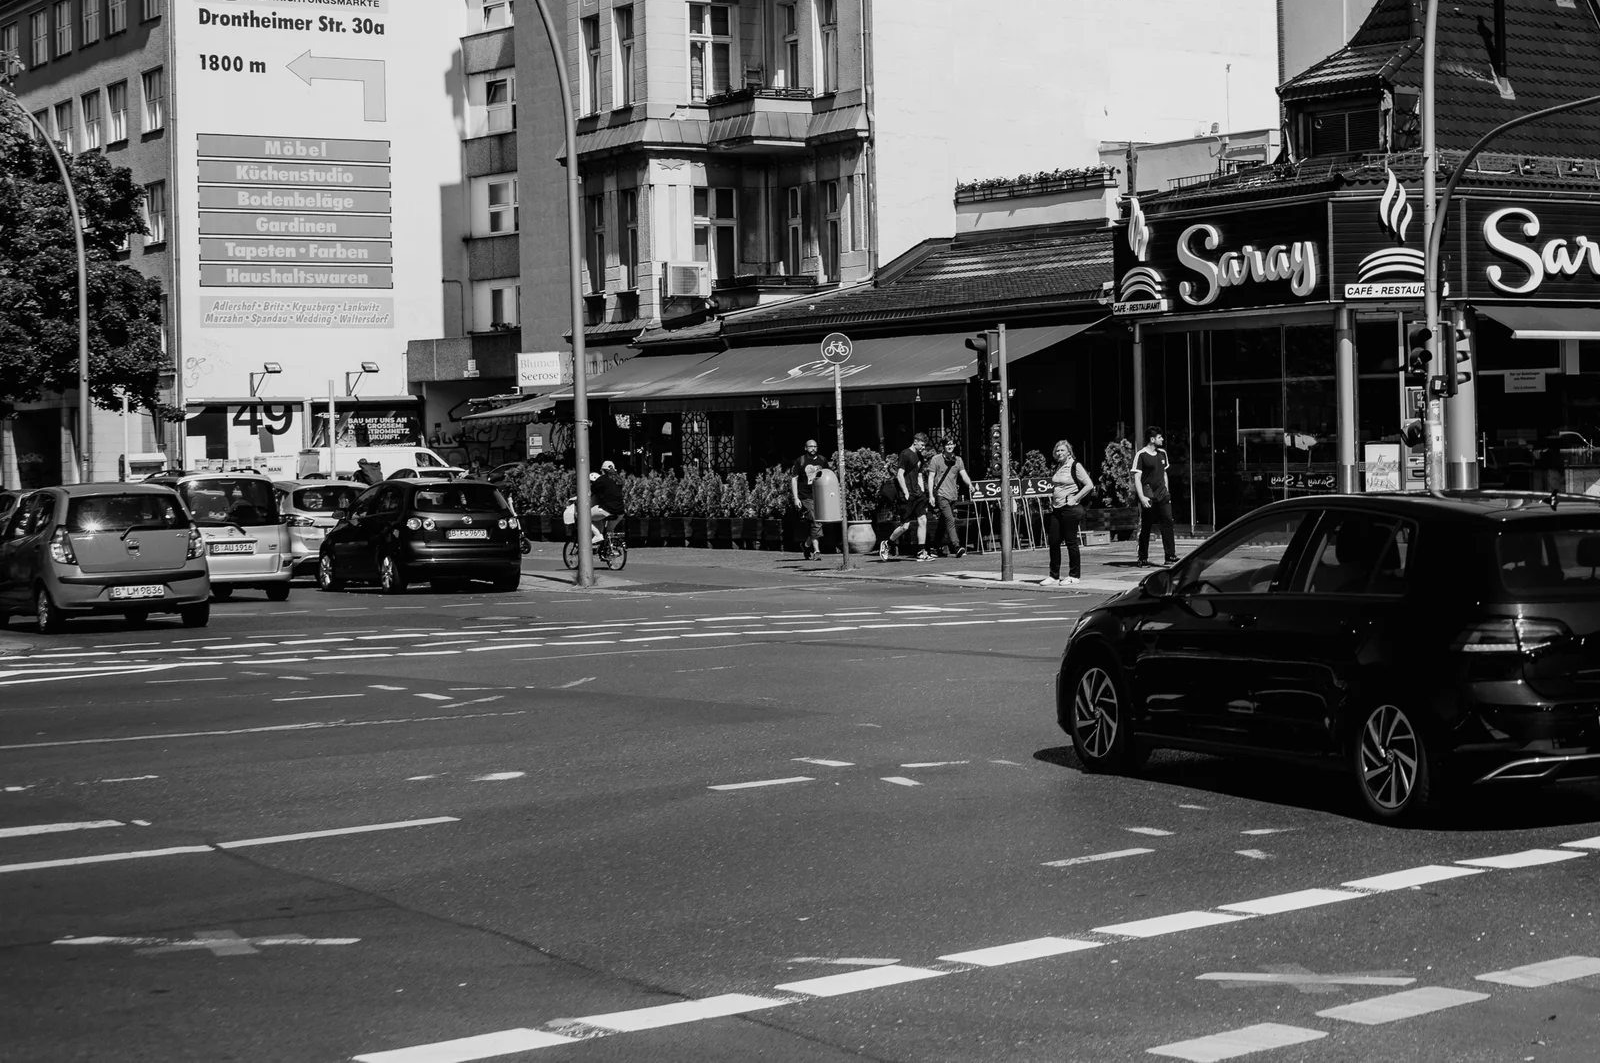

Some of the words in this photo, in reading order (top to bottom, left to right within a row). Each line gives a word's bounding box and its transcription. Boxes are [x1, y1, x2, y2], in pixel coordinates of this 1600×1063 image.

[198, 7, 313, 31] Drontheimer
[318, 15, 347, 33] Str.
[352, 17, 385, 35] 30a
[199, 54, 244, 72] 1800
[249, 60, 266, 73] m
[265, 140, 327, 157] Möbel
[236, 165, 354, 184] Küchenstudio
[237, 191, 354, 211] Bodenbeläge
[255, 217, 337, 234] Gardinen
[225, 242, 296, 260] Tapeten
[309, 244, 369, 259] Farben
[1176, 223, 1320, 306] Saray
[226, 268, 369, 285] Haushaltswaren
[1347, 285, 1373, 295] CAFÉ
[212, 301, 257, 311] Adlershof
[263, 302, 285, 311] Britz
[292, 302, 336, 313] Kreuzberg
[1129, 302, 1160, 312] RESTAURANT
[520, 359, 559, 368] Blumen
[521, 371, 559, 381] Seerose
[235, 543, 253, 551] 1916
[127, 586, 139, 595] LM
